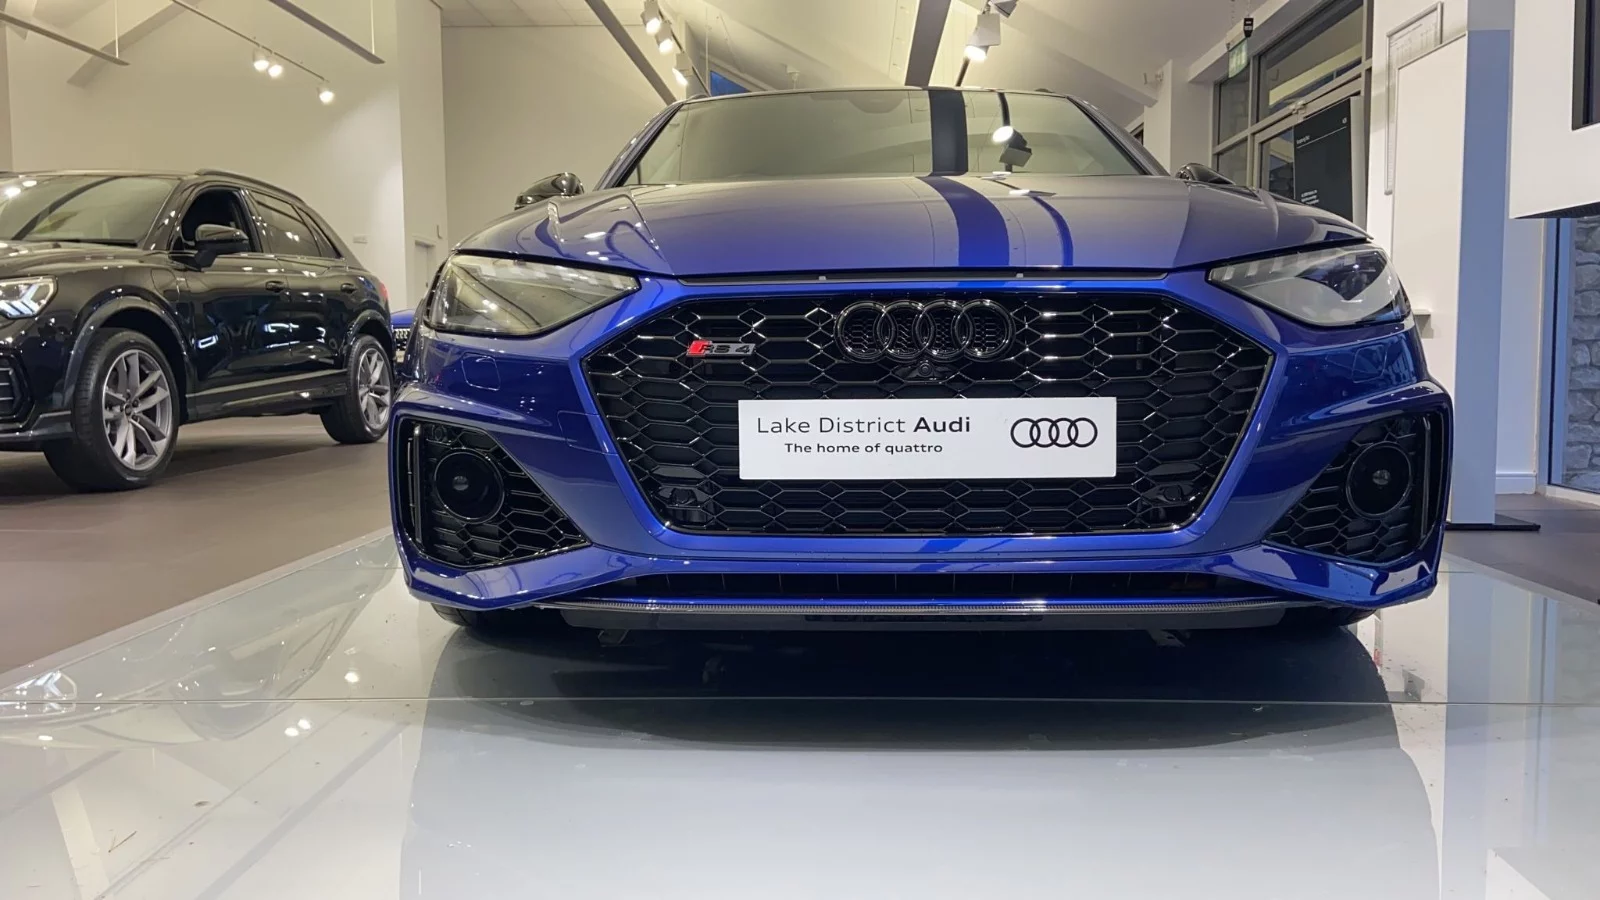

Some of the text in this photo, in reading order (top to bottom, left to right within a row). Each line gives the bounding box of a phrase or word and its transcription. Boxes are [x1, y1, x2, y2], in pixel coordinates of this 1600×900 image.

[757, 416, 970, 434] Lake District Audi
[784, 442, 943, 456] The home of quattro
